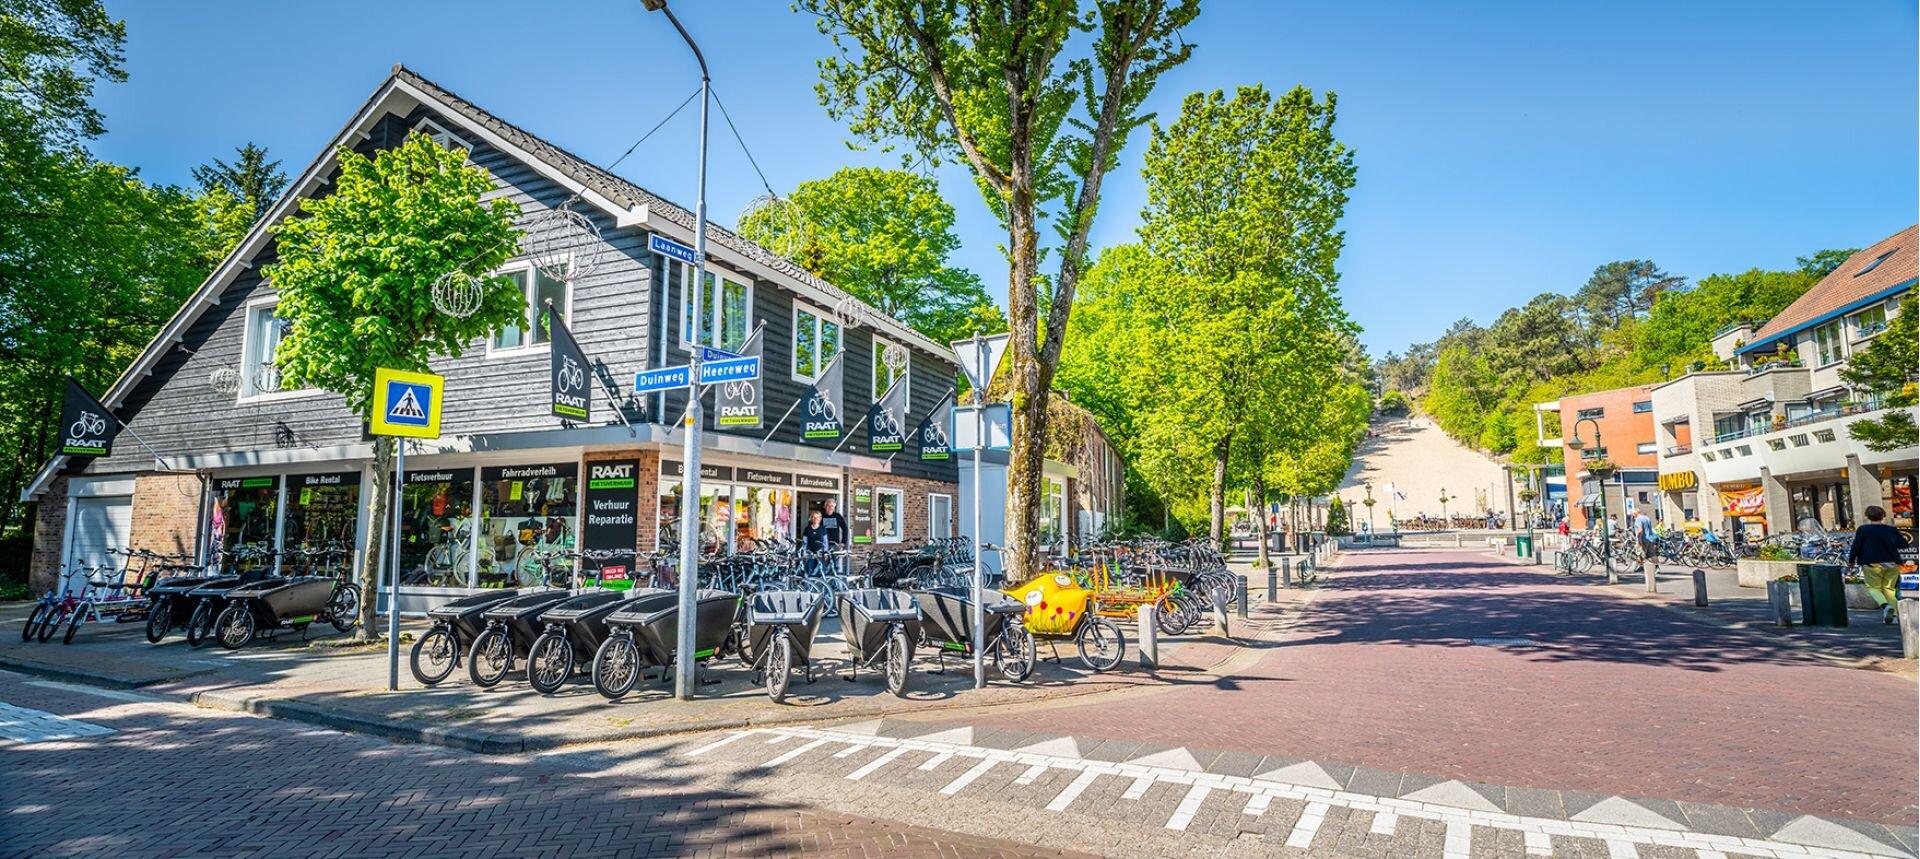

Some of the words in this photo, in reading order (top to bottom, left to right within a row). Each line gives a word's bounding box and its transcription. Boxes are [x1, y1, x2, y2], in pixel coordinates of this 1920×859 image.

[655, 239, 693, 260] Laanweg
[703, 363, 756, 378] Heereweg
[640, 372, 684, 386] Duinweg
[555, 393, 586, 407] RAAT
[721, 406, 758, 416] RAAT
[806, 421, 838, 431] RAAT
[65, 438, 107, 448] RAAT
[872, 435, 901, 444] RAAT
[922, 446, 948, 454] RAAT
[410, 472, 454, 482] Fietsverhuur
[501, 466, 557, 478] Fahrradverleih
[591, 464, 634, 479] RAAT
[700, 468, 718, 478] ental
[747, 471, 782, 483] Fietsverhuur
[221, 480, 240, 488] RAAT
[1658, 470, 1694, 491] JUMBO
[593, 499, 630, 510] Verhuur
[588, 513, 634, 526] Reparatie
